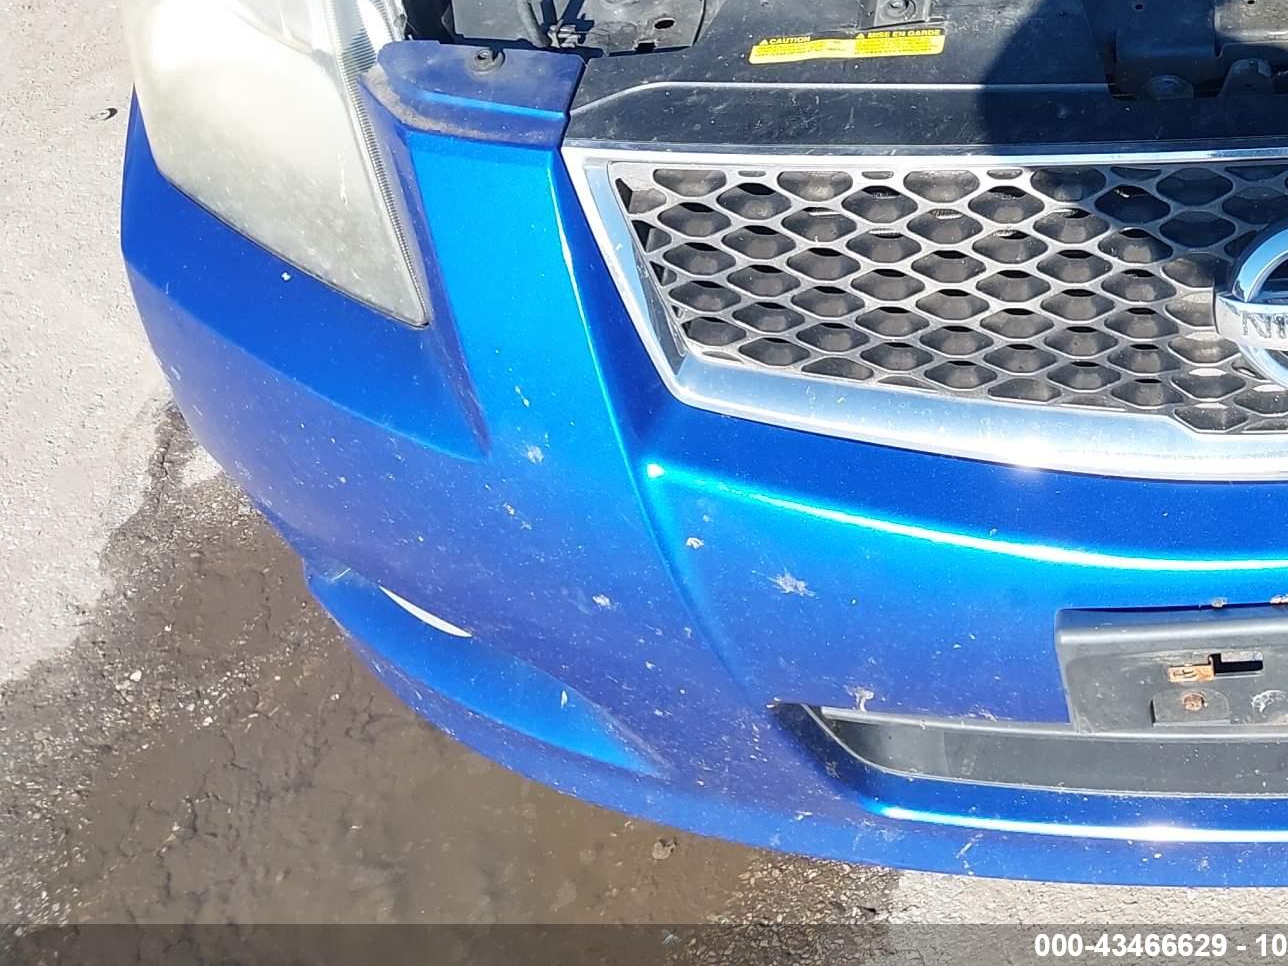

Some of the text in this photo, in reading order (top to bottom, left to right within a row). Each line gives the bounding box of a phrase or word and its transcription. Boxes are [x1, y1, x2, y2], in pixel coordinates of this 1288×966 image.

[892, 30, 906, 38] EN
[907, 28, 941, 37] GARDE
[769, 36, 811, 45] CAUTION
